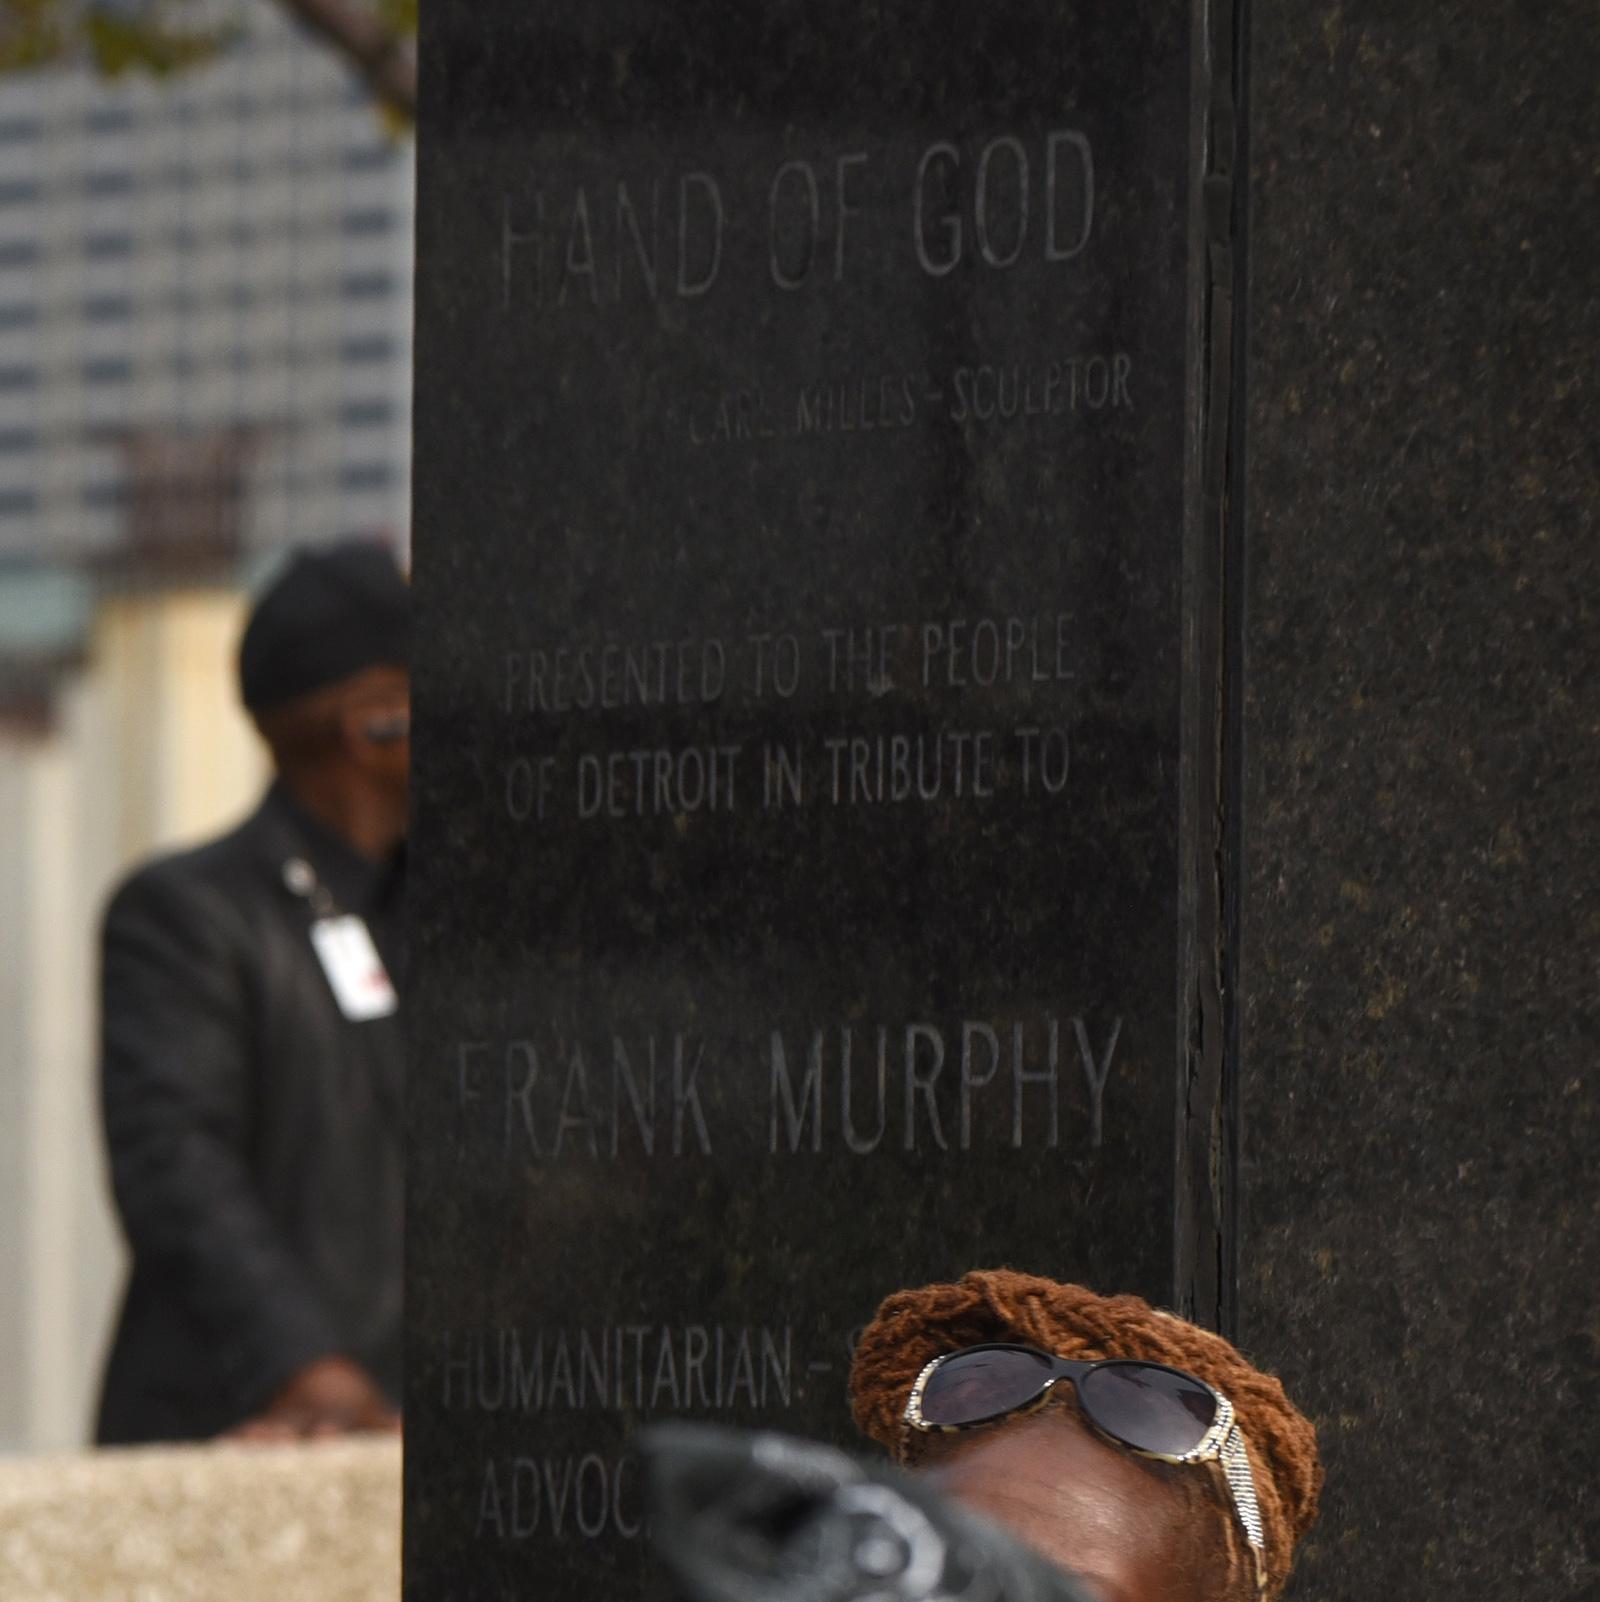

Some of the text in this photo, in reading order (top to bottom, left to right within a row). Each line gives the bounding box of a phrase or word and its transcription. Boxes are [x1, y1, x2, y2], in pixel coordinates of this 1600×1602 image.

[499, 127, 1096, 312] HAND OF GOD
[798, 372, 917, 434] MILLES
[950, 351, 1135, 424] SCULPTOR
[504, 611, 1077, 715] PRESENTED TO THE PEOPLE
[505, 724, 1071, 822] OF DETROIT IN TRIBUTE TO
[457, 1013, 1124, 1161] FRANK MURPHY
[441, 1322, 794, 1412] HUMANITARIAN
[474, 1450, 653, 1540] ADVOC
